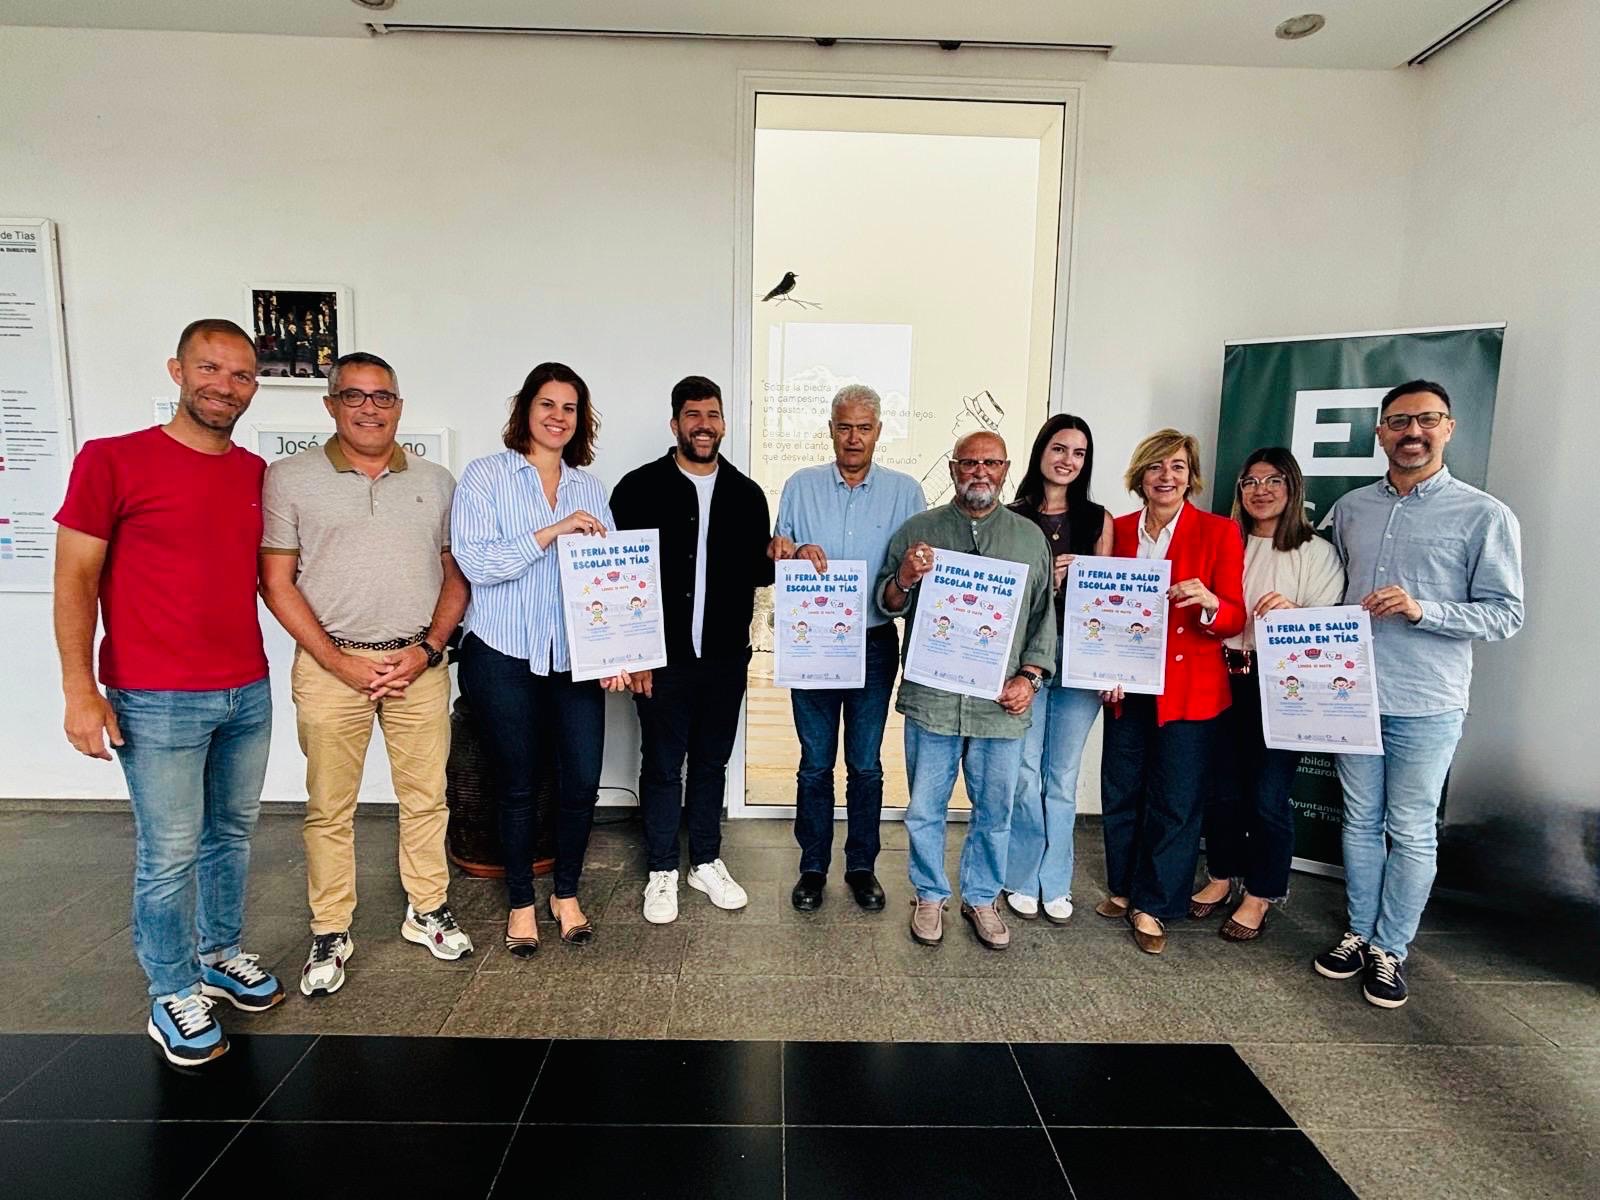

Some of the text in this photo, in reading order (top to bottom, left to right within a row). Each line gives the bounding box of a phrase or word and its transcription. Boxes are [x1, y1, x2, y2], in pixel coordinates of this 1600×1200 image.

[275, 435, 319, 455] José
[571, 544, 650, 558] II FERIA DE SALUD
[573, 555, 650, 570] ESCOLAR EN TÍAS
[785, 574, 859, 582] II FERIA DE SALUD
[935, 563, 1016, 586] II FERIA DE SALUD
[1078, 570, 1160, 582] II FERIA DE SALUD
[786, 583, 857, 593] ESCOLAR EN TÍAS
[934, 575, 1013, 597] ESCOLAR EN TÍAS
[1078, 581, 1158, 593] ESCOLAR EN TÍAS
[1266, 621, 1359, 633] II FERIA DE SALUD
[1268, 632, 1359, 645] ESCOLAR EN TÍAS
[1303, 809, 1317, 819] de
